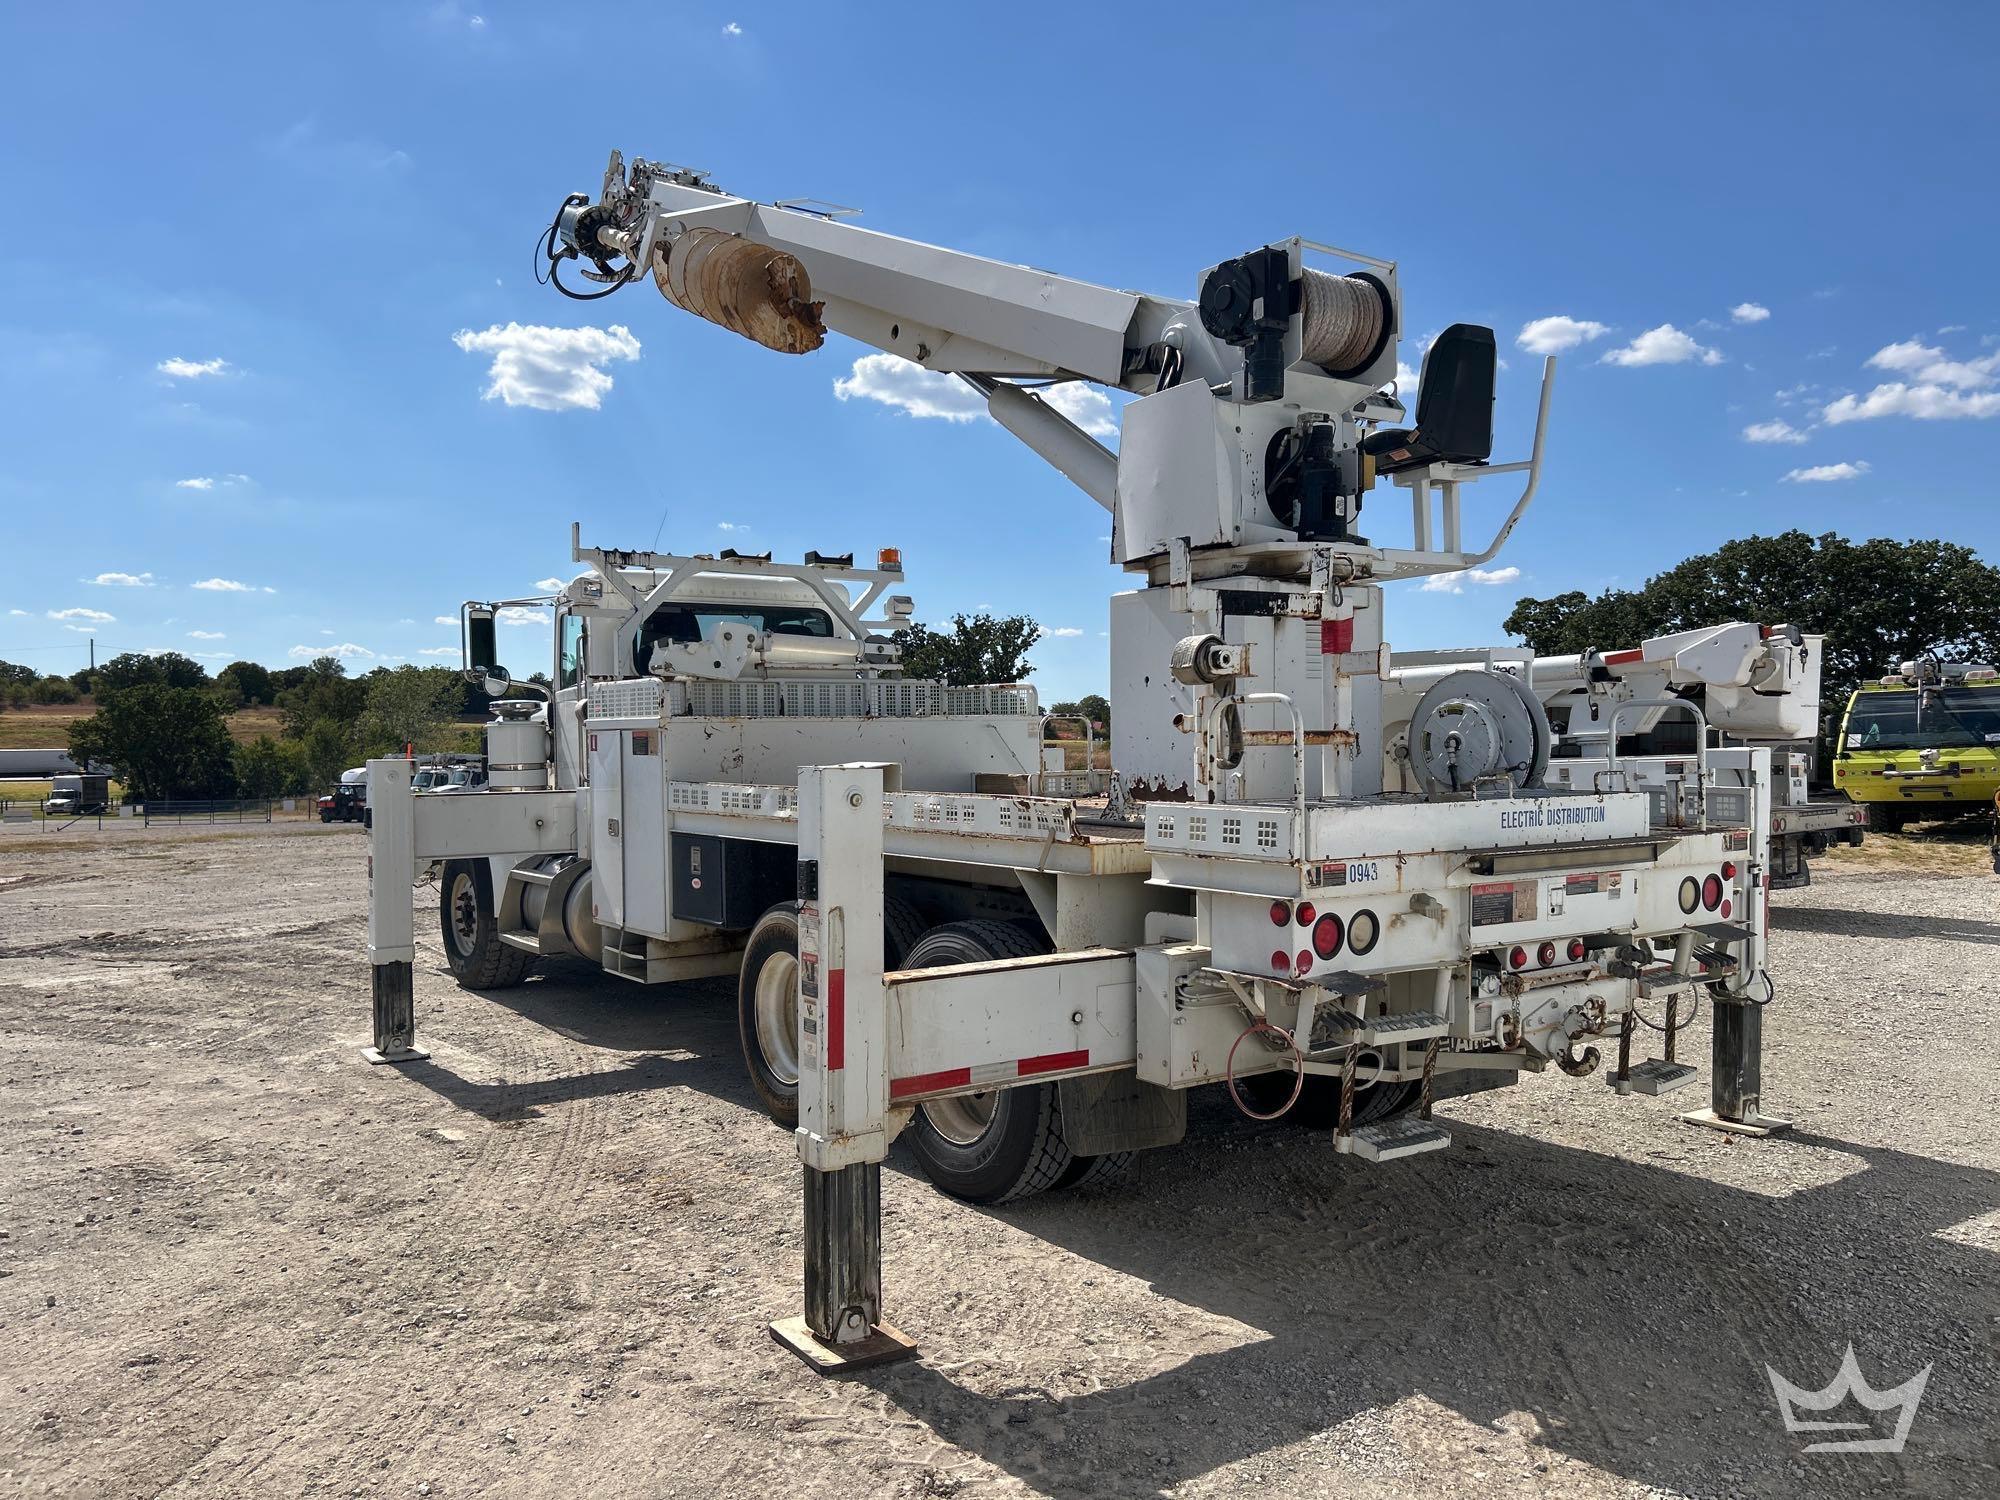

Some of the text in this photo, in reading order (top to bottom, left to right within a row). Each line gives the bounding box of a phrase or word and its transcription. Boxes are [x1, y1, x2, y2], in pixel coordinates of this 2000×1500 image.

[1501, 806, 1605, 829] ELECTRIC DISTRIBUTION
[1349, 862, 1378, 883] 0943
